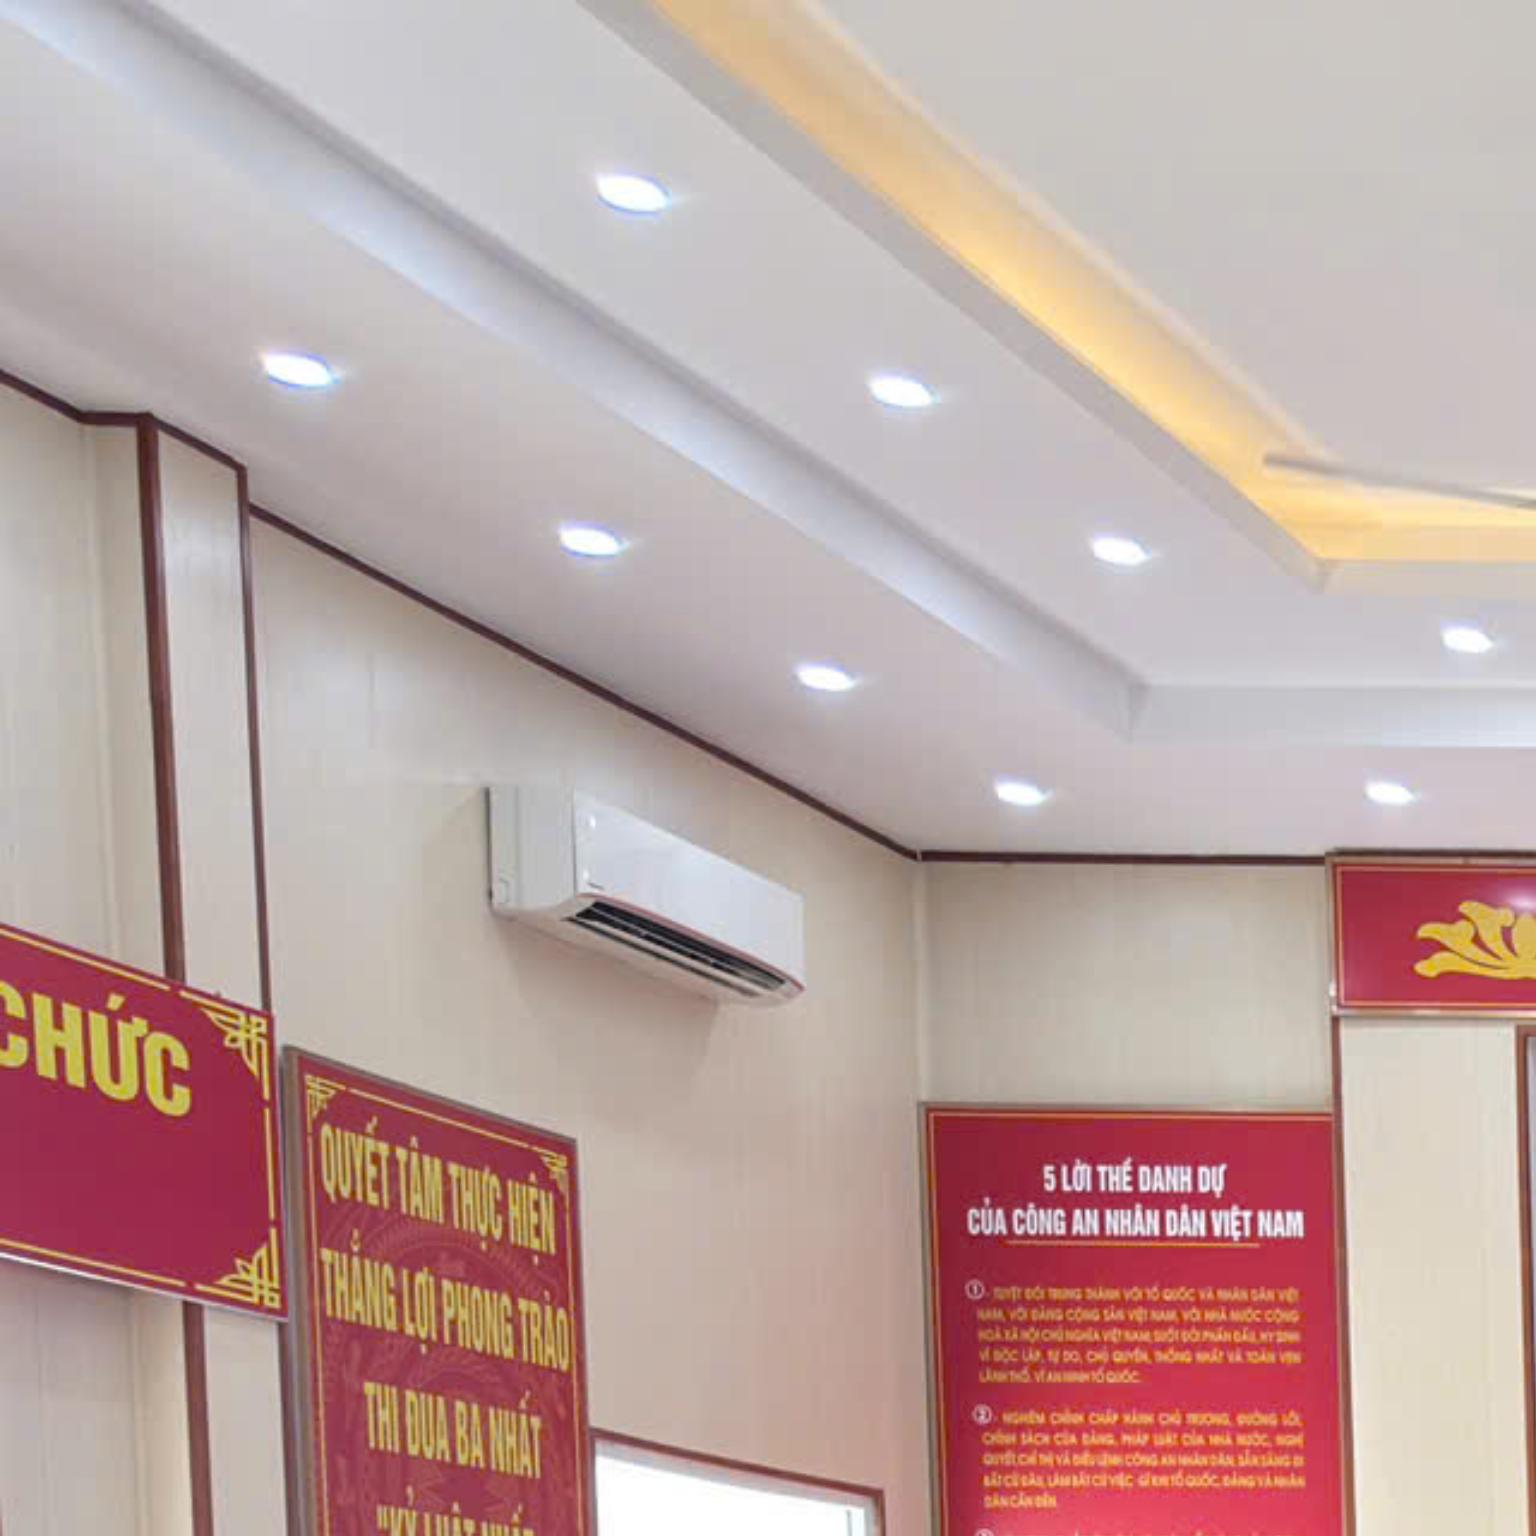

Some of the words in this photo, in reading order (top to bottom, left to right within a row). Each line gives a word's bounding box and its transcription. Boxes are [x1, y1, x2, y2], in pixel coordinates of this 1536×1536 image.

[321, 1115, 389, 1210] QUYẾT
[396, 1136, 444, 1224] TÂM
[448, 1165, 502, 1250] THỰC
[508, 1172, 555, 1265] HIỆN
[967, 1197, 1006, 1235] CỦA
[1012, 1203, 1066, 1236] CÔNG
[1072, 1209, 1099, 1236] AN
[1105, 1204, 1160, 1236] NHÂN
[1165, 1203, 1205, 1236] DÂN
[1210, 1204, 1252, 1241] VIỆT
[1258, 1210, 1304, 1237] NAM
[1044, 1165, 1056, 1191] 5
[1061, 1158, 1092, 1191] LỜI
[1139, 1166, 1191, 1192] DANH
[1198, 1163, 1227, 1198] DỰ
[402, 1267, 437, 1354] LỢI
[442, 1279, 514, 1359] PHONG
[518, 1290, 569, 1372] TRÀO
[364, 1381, 399, 1453] THI
[405, 1389, 451, 1461] ĐUA
[455, 1400, 485, 1468] BA
[489, 1390, 541, 1479] NHẤT
